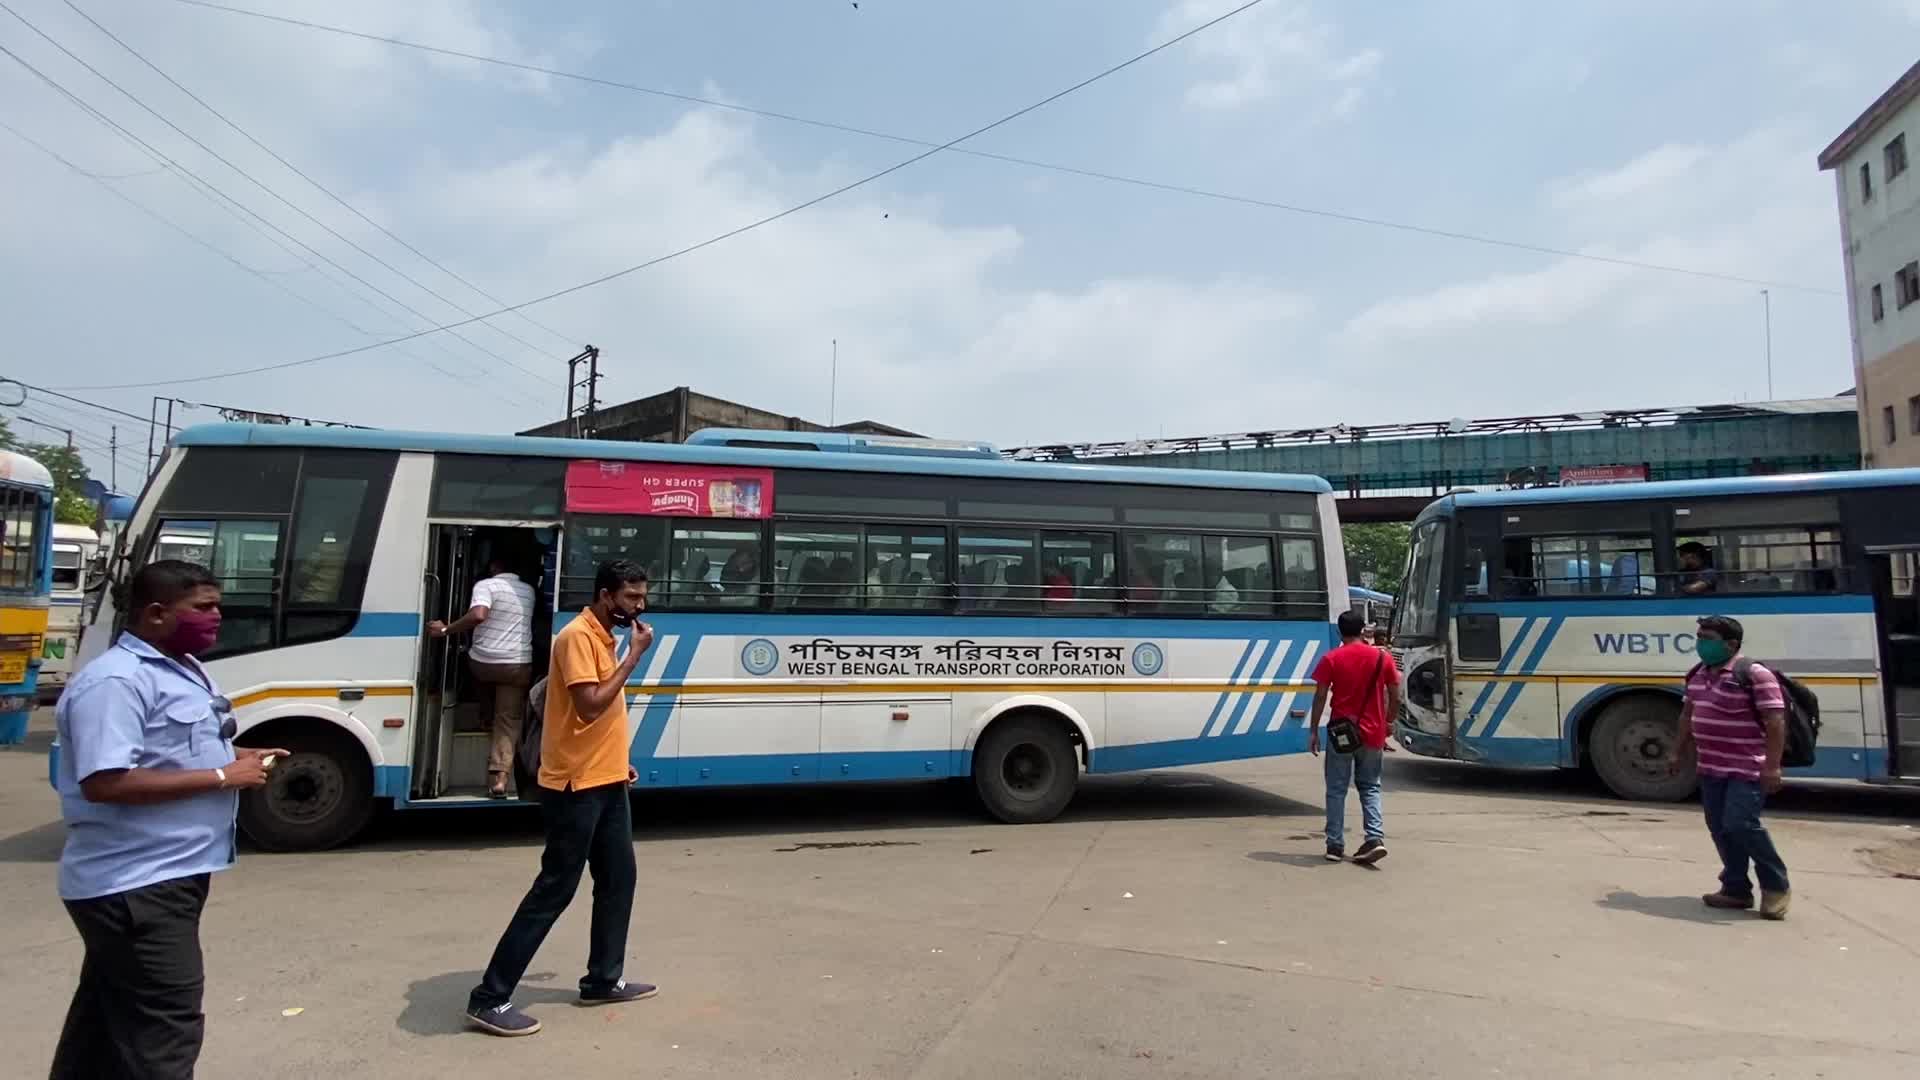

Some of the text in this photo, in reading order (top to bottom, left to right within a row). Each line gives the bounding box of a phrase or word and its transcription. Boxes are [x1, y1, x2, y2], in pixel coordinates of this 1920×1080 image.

[643, 477, 705, 488] SUPER GH
[788, 638, 1125, 662] পশ্চিমবঙ্গ পরিবহন নিগম
[1593, 632, 1696, 654] WBTC
[788, 662, 1126, 676] WEST BENGAL TRANSPORT CORPORATION
